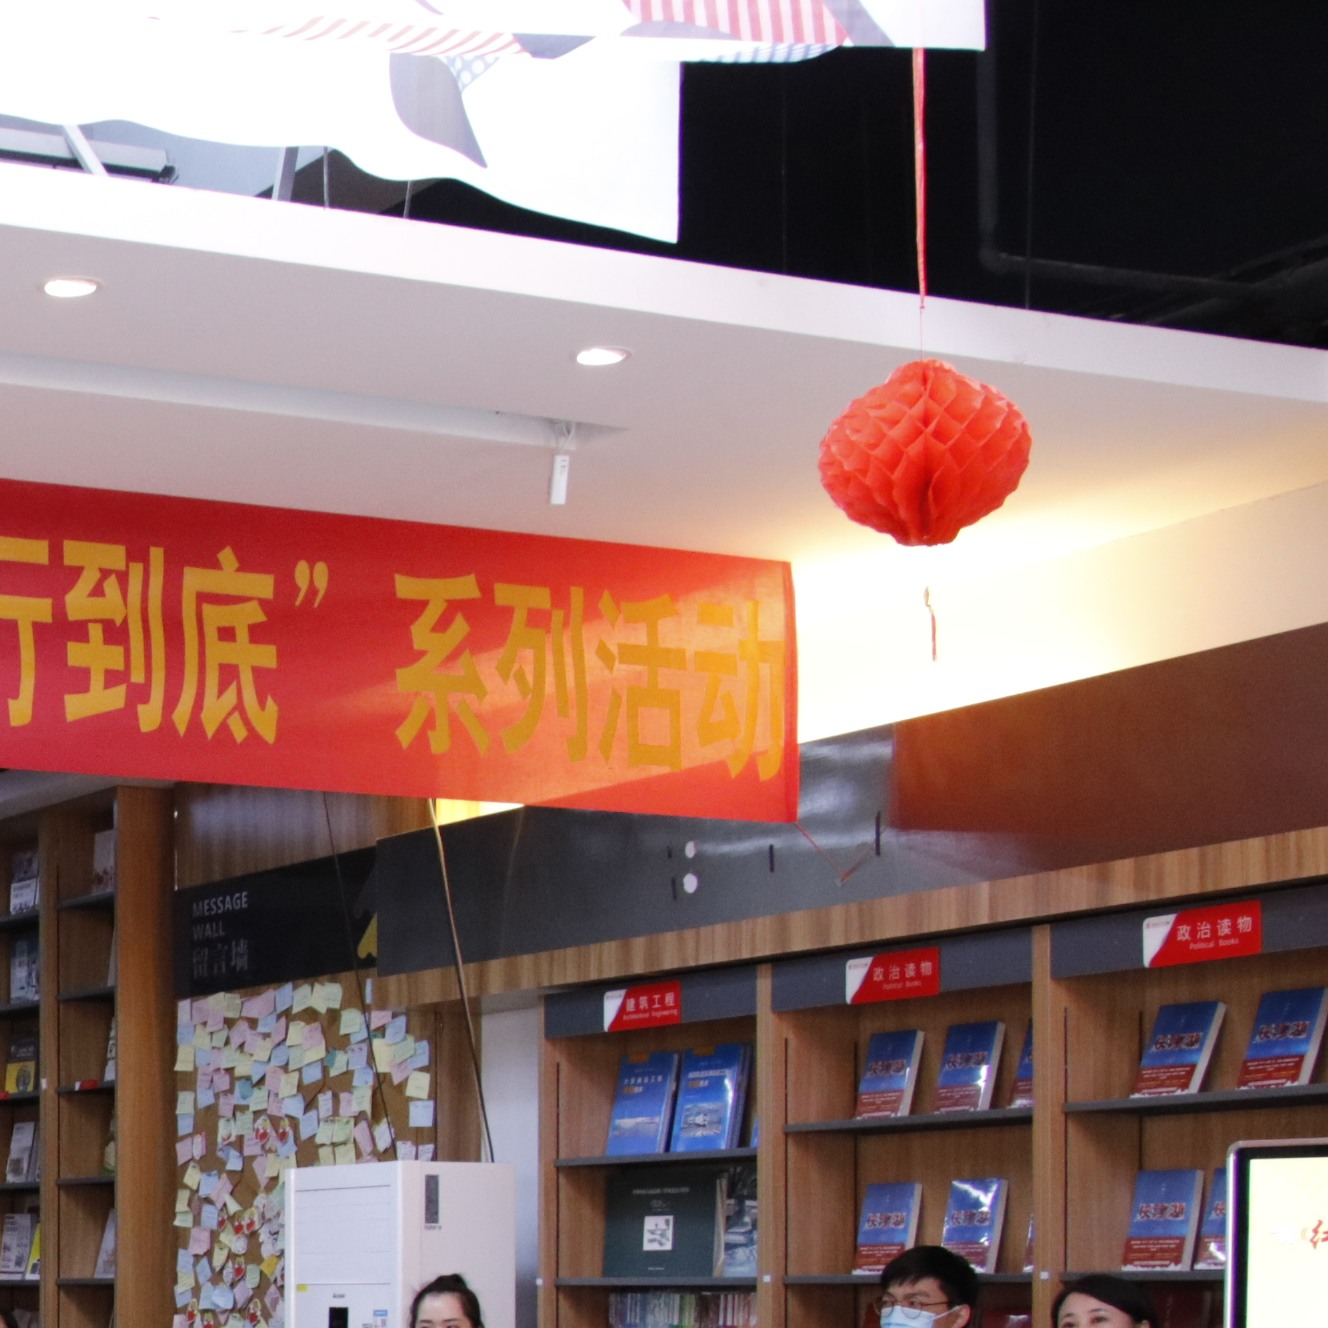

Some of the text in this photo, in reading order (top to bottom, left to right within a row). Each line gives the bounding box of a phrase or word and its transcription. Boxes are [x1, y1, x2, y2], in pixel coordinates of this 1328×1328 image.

[192, 892, 248, 917] MESSAGE
[192, 922, 226, 938] WALL
[1176, 915, 1253, 942] 政治读物
[872, 961, 933, 982] 政治读物
[625, 992, 676, 1012] 建筑工程
